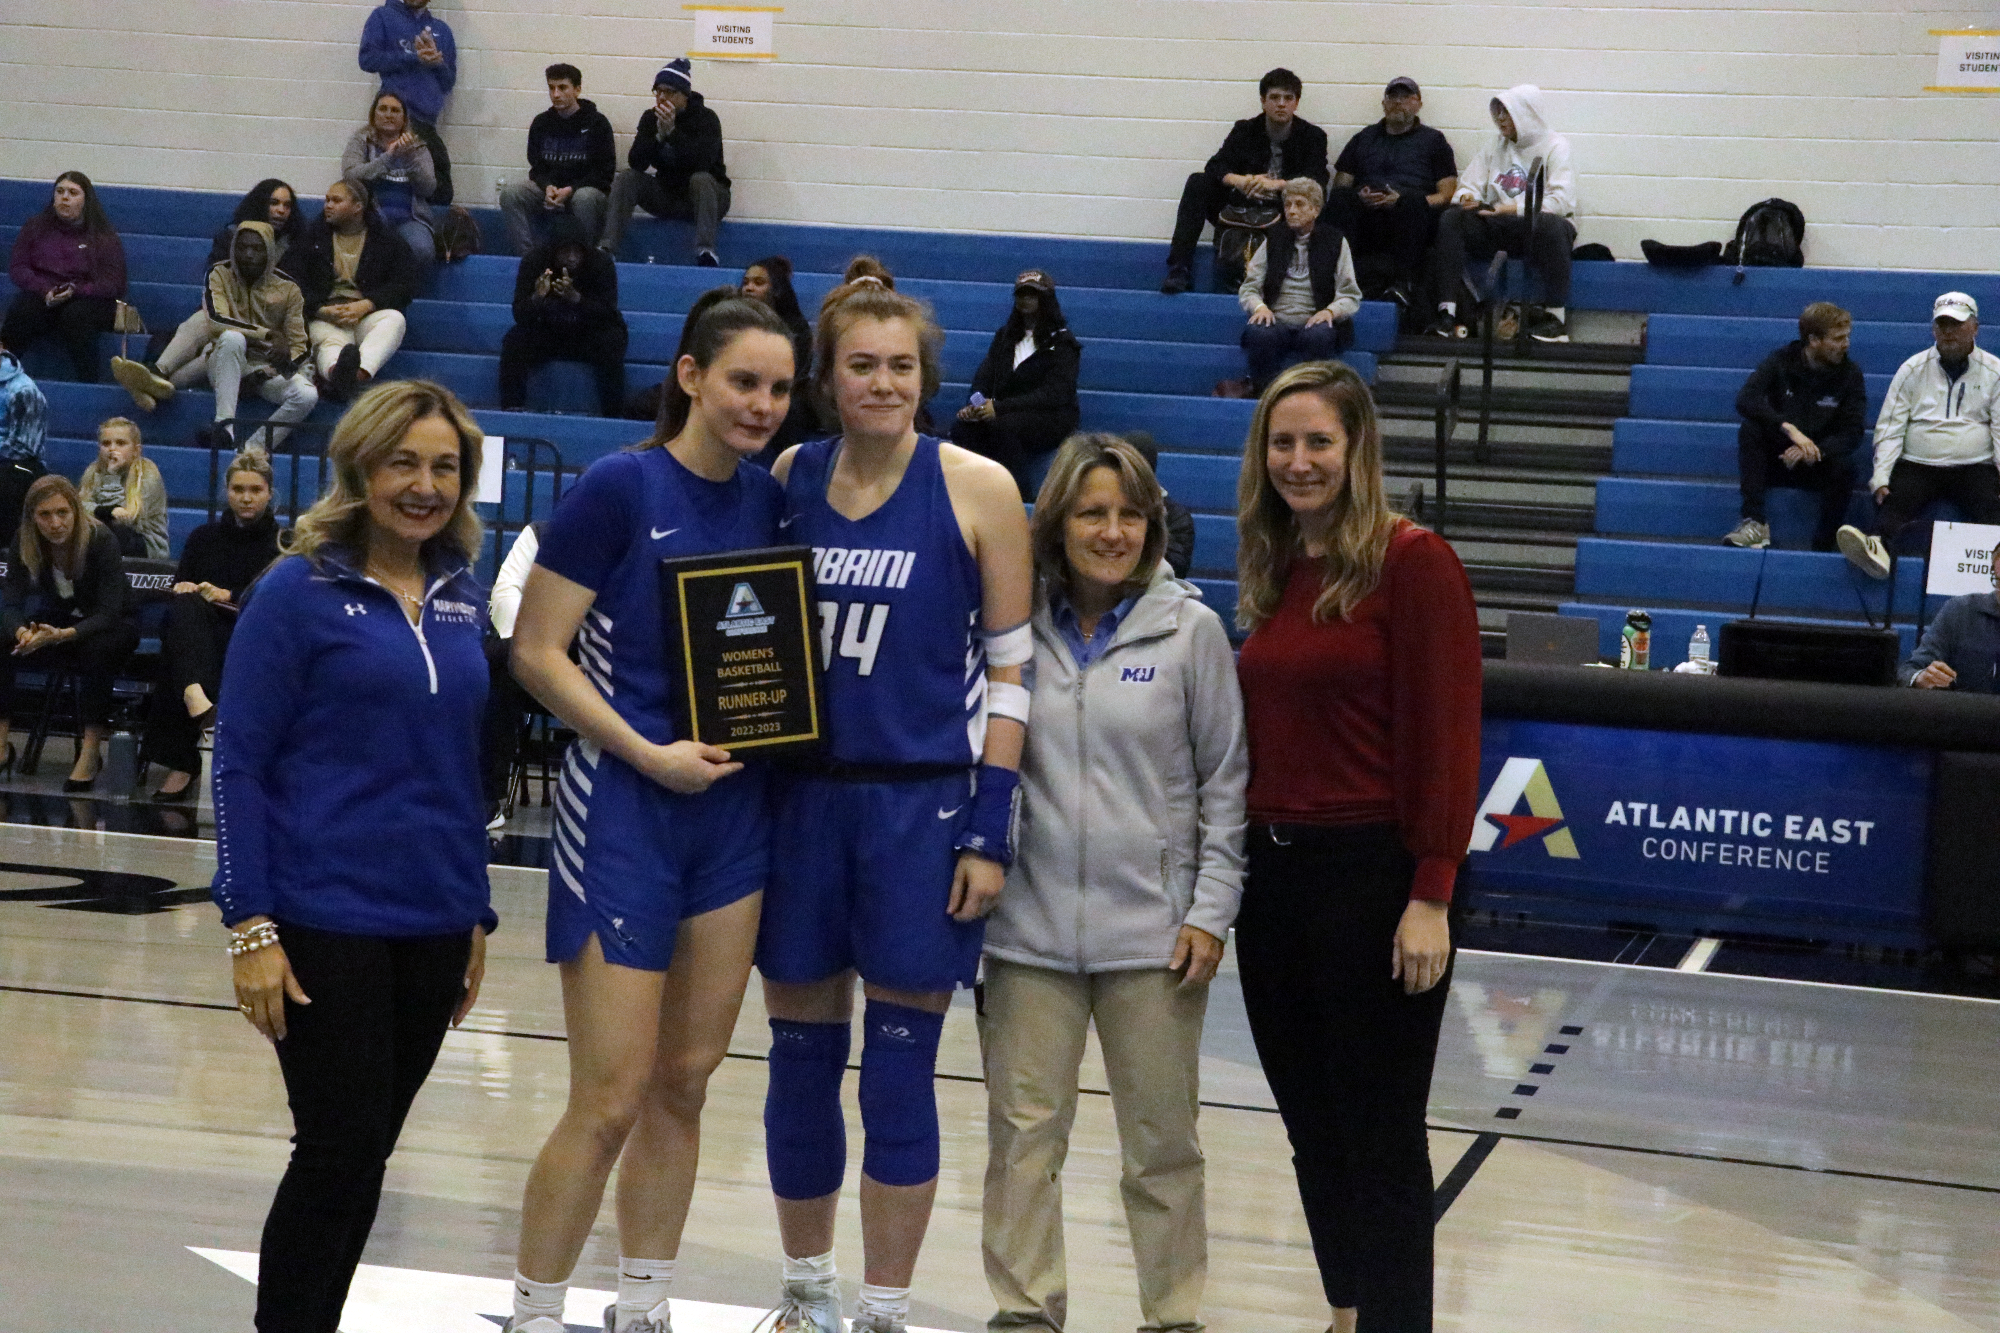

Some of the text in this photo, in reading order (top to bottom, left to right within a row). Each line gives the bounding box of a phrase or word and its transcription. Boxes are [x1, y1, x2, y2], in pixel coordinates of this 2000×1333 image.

[716, 25, 751, 33] VISITING
[712, 36, 754, 44] STUDENTS
[1965, 51, 2000, 60] VISITIN
[721, 647, 774, 662] WOMEN'S
[717, 662, 782, 678] BASKETBALL
[718, 689, 787, 711] RUNNER-UP
[731, 722, 781, 737] 2022-2023
[1605, 800, 1875, 846] ATLANTIC EAST
[1642, 837, 1831, 874] CONFERENCE
